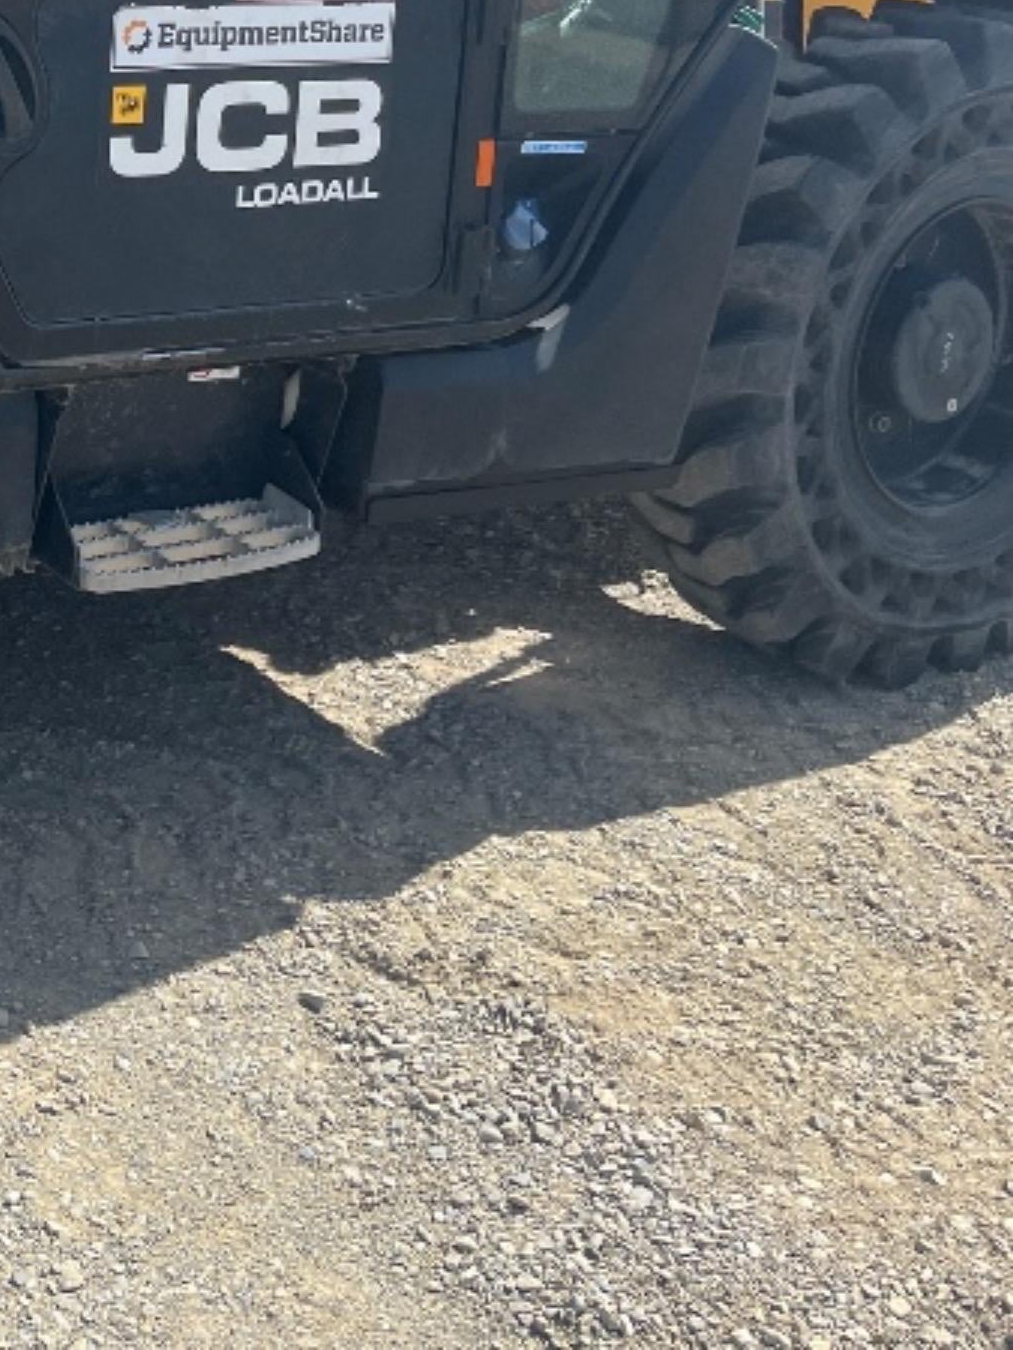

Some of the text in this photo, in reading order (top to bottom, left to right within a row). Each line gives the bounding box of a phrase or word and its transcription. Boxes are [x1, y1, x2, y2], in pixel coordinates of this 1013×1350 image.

[157, 19, 385, 51] EquipmentShare
[109, 79, 383, 178] JCB
[236, 177, 379, 208] LOADALL
